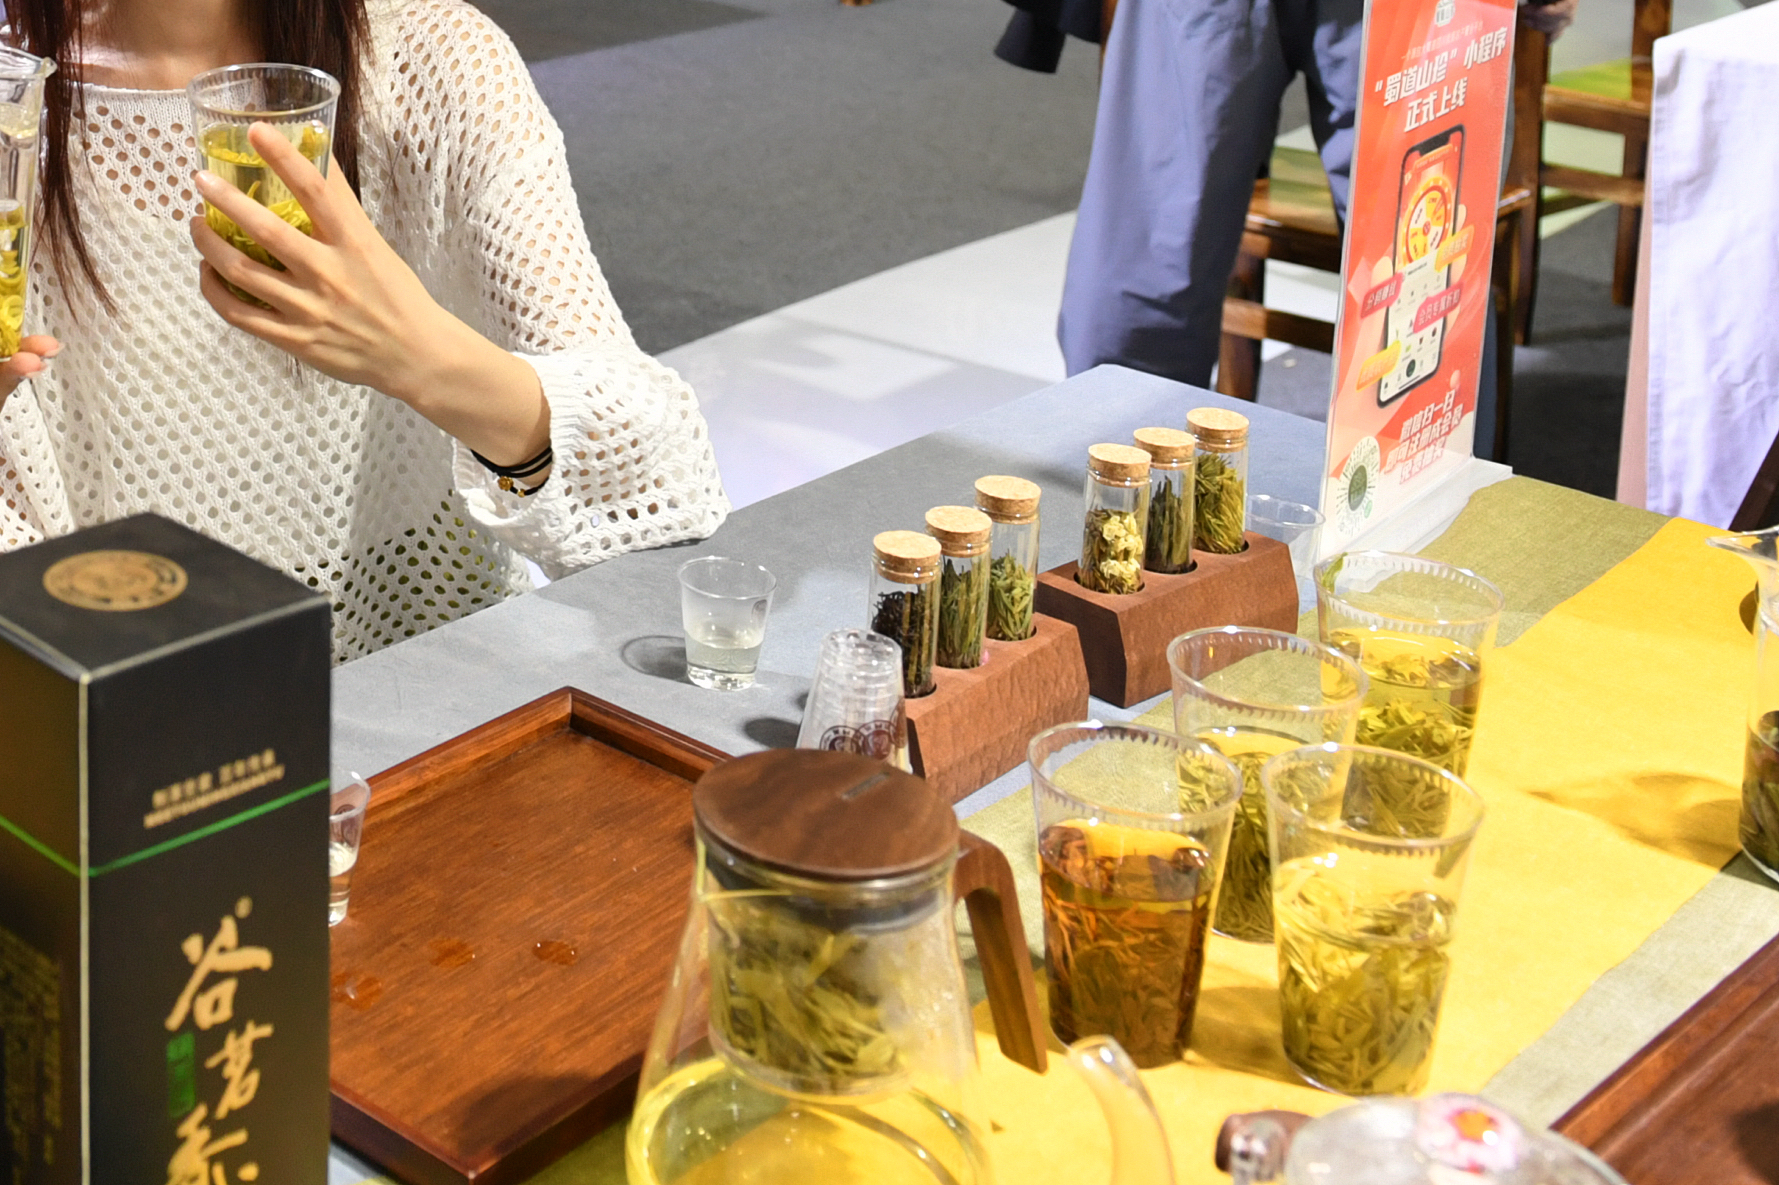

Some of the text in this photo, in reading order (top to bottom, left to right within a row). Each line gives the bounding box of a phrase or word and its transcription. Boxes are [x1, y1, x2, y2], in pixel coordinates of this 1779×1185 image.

[1403, 76, 1469, 133] 正式上线
[1398, 389, 1456, 443] 微信扫一扫
